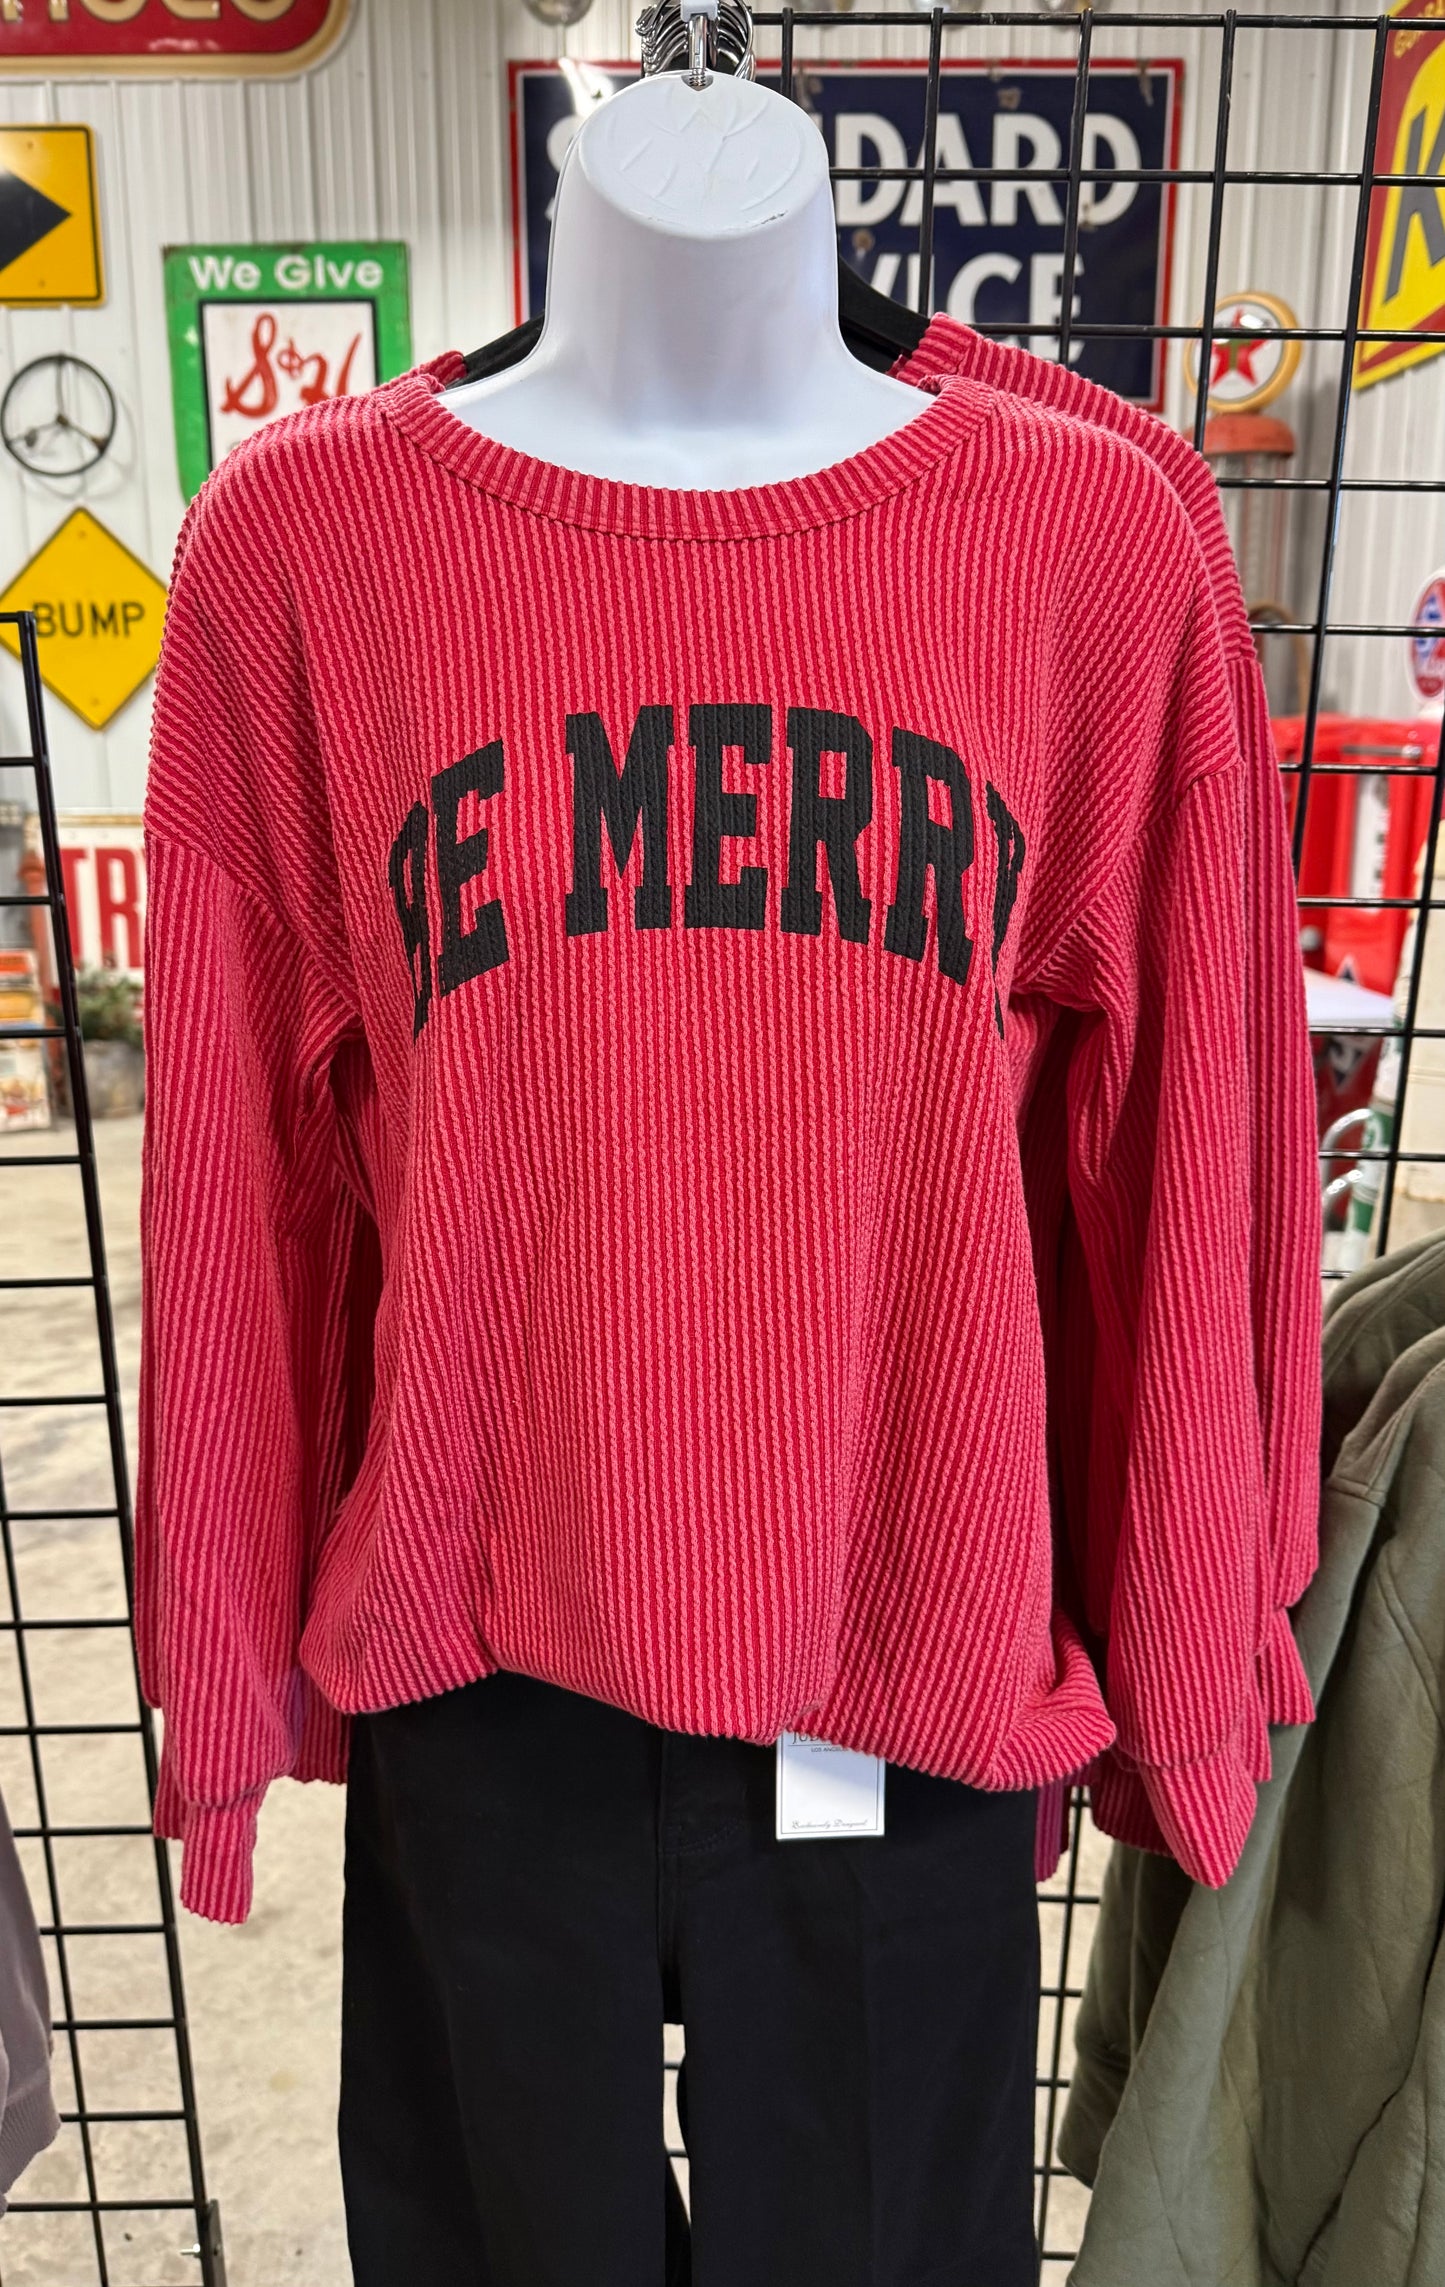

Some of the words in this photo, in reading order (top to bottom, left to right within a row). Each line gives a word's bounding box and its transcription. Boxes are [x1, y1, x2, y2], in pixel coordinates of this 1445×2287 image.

[189, 256, 261, 290] We
[273, 256, 383, 290] Give
[33, 602, 145, 637] BUMP
[59, 847, 146, 969] TR
